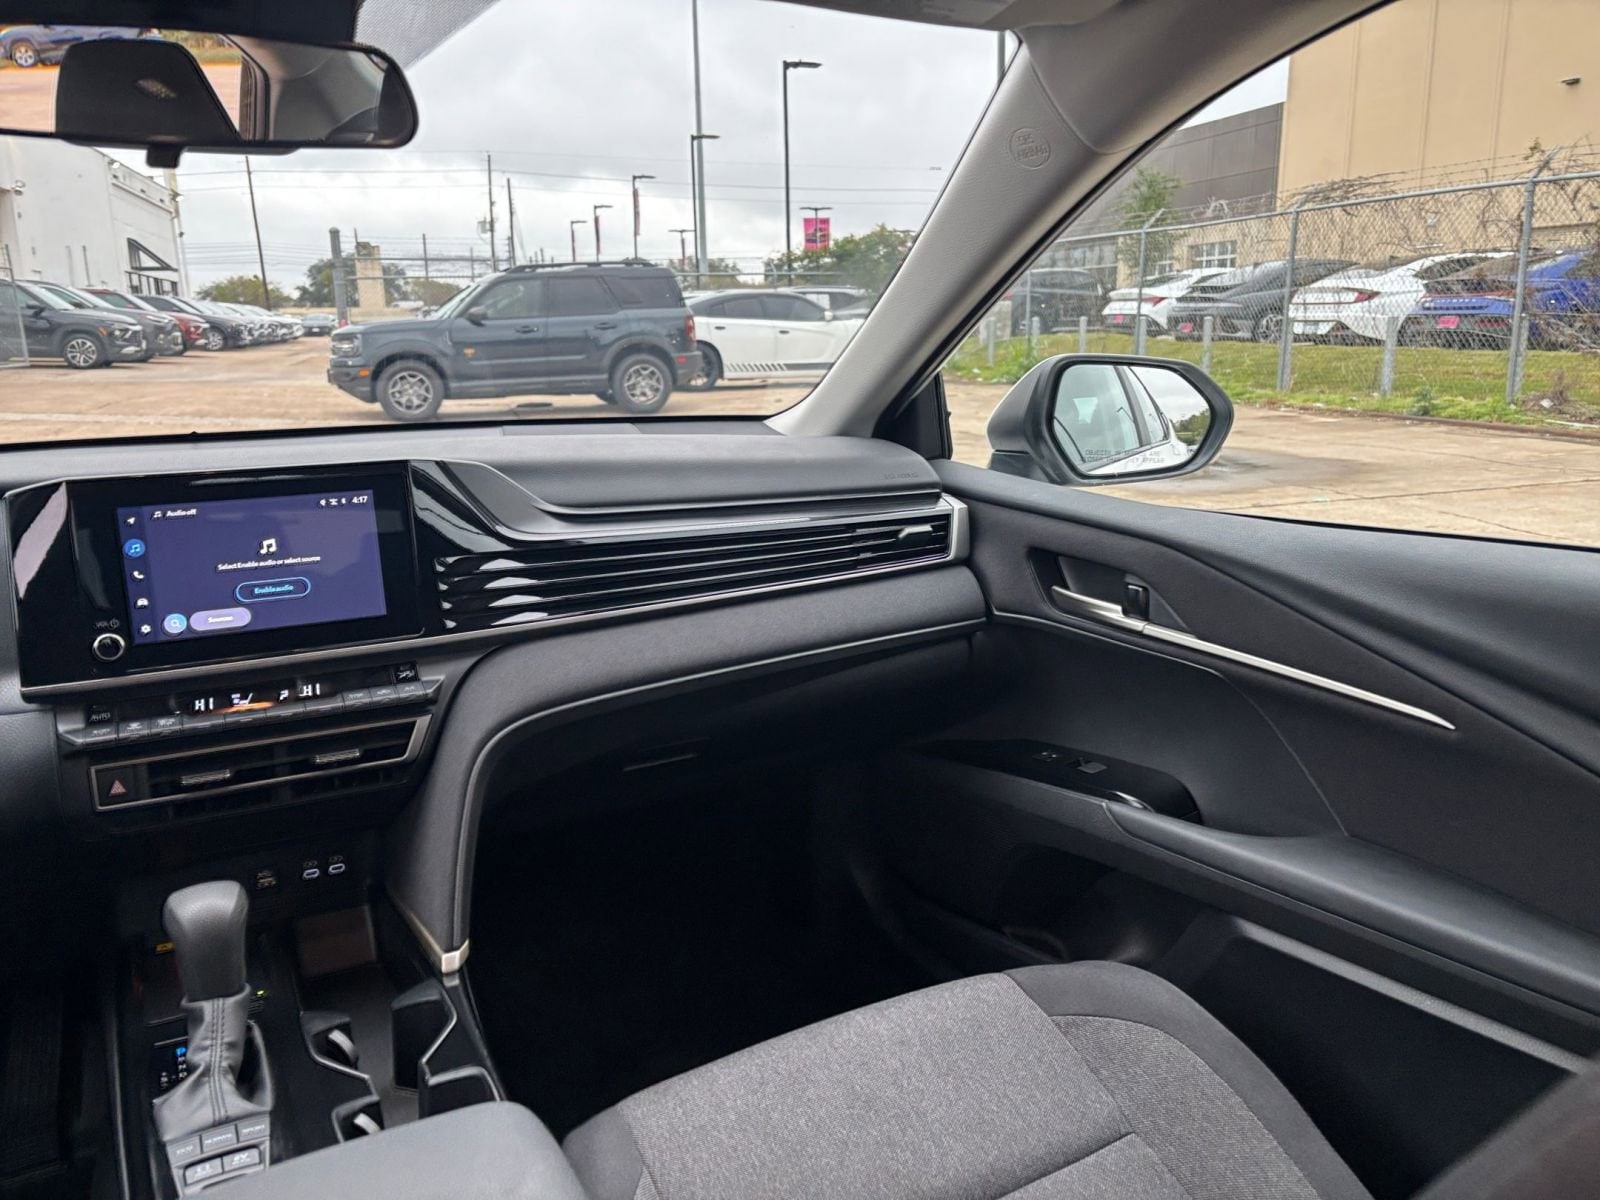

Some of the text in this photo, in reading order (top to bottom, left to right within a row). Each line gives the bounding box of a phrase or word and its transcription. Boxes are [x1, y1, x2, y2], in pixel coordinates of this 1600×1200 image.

[351, 495, 368, 504] 4:17
[254, 586, 275, 595] Enable
[194, 697, 214, 712] HI
